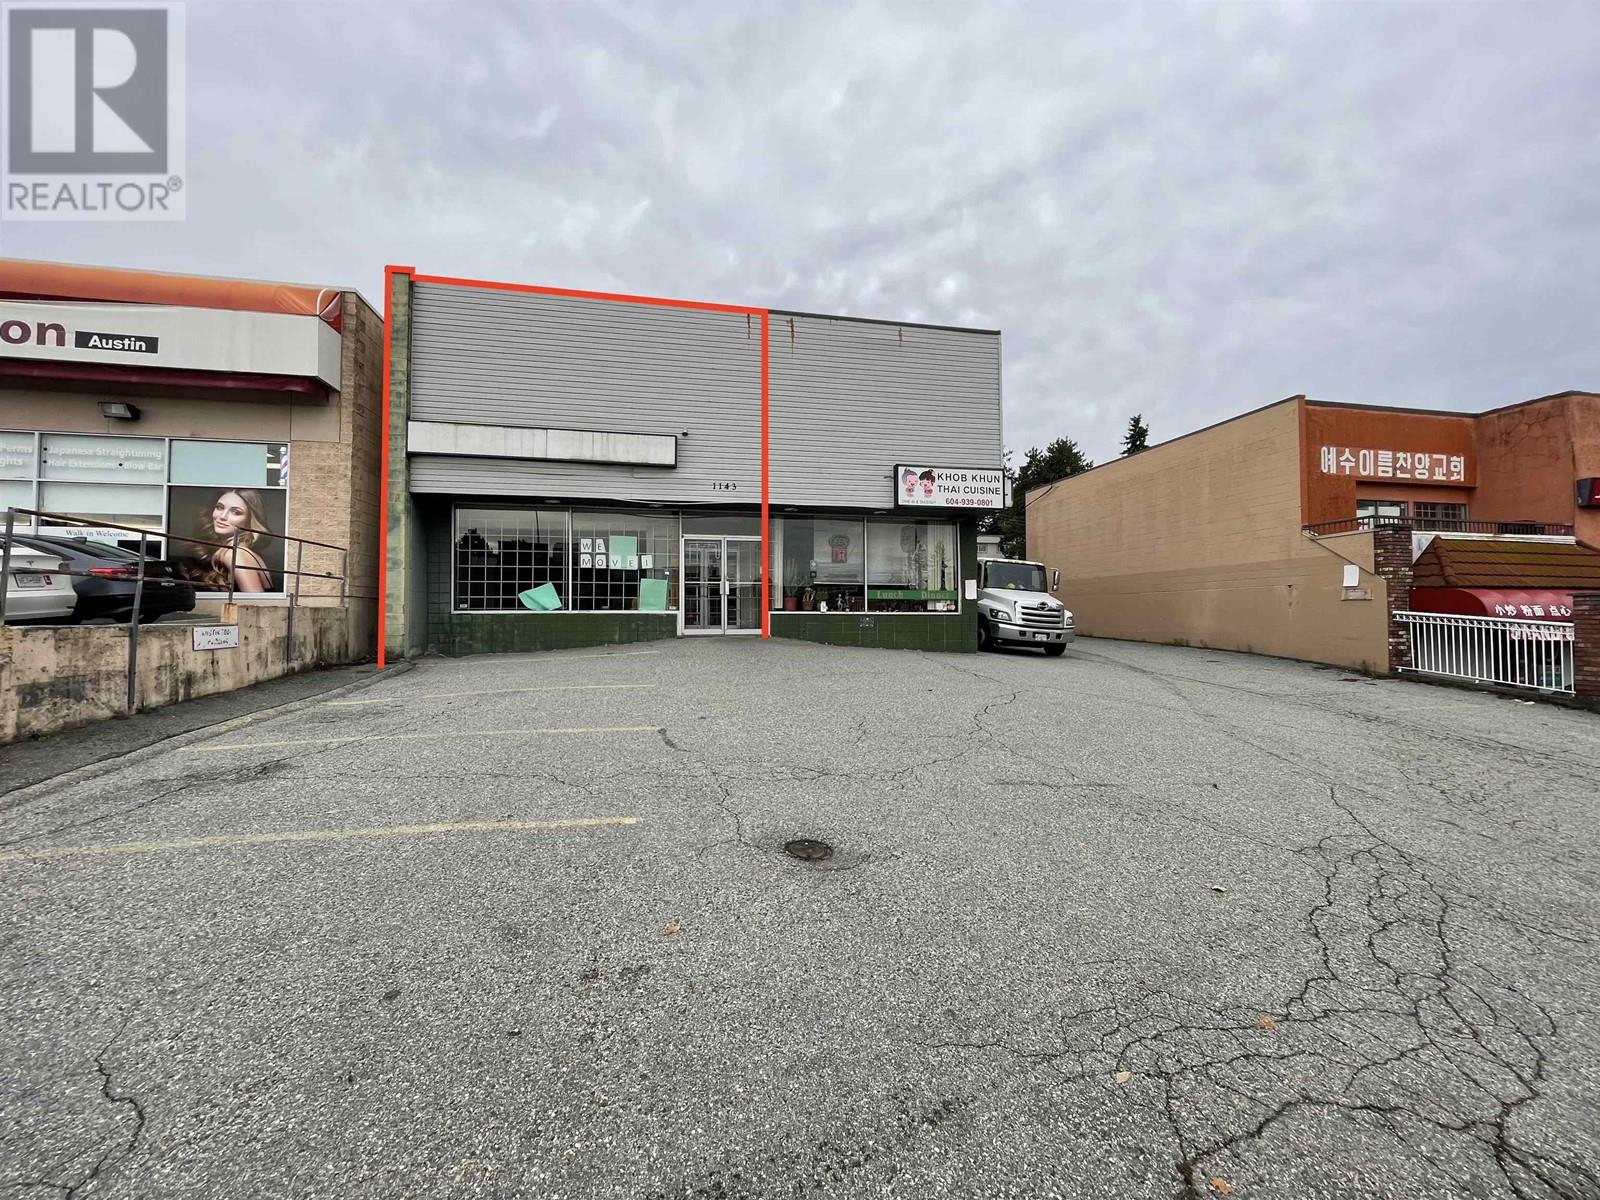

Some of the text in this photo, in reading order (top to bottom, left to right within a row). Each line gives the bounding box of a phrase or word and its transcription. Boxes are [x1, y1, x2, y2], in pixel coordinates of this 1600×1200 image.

[0, 319, 66, 347] on
[88, 335, 146, 351] Austin
[1320, 446, 1465, 482] 예수이름찬양교회
[937, 472, 1000, 484] KHOB KHUN
[713, 482, 737, 491] 1143
[937, 485, 1001, 495] THAI CUISINE
[945, 497, 993, 506] 604-939-0801
[65, 529, 84, 537] Walk
[96, 530, 129, 538] Welcome
[582, 543, 603, 551] WE
